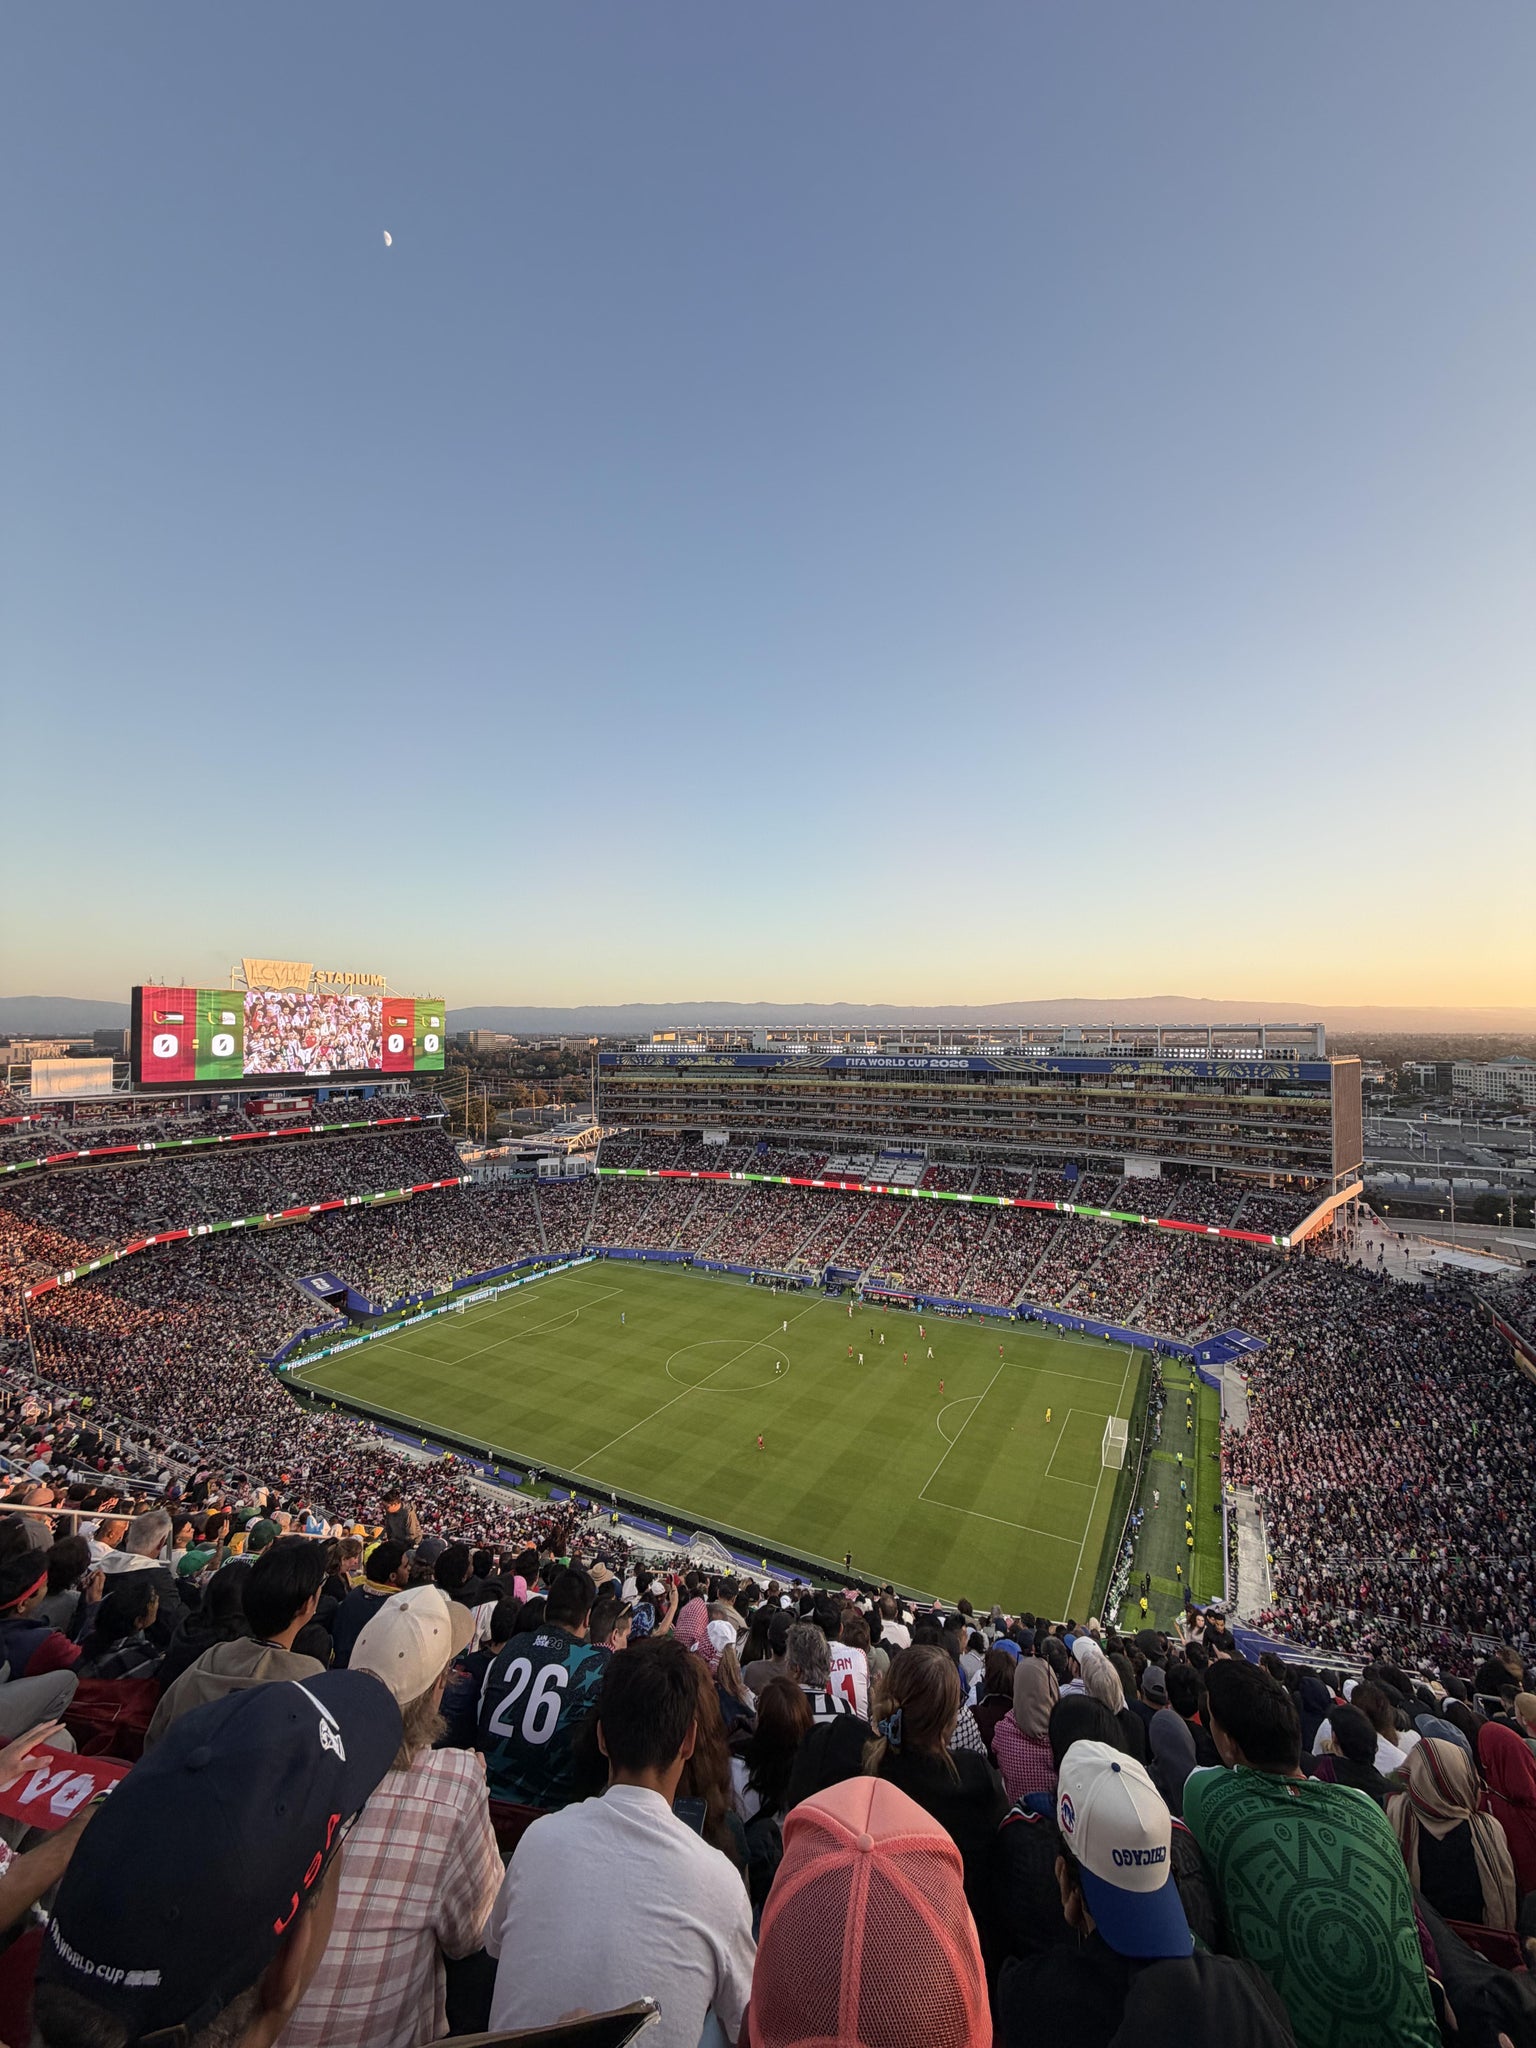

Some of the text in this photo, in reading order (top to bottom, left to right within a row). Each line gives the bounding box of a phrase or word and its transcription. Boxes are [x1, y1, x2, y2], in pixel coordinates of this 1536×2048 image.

[315, 970, 383, 987] STADIUM
[153, 1034, 178, 1058] 0
[212, 1034, 234, 1057] 0
[845, 1058, 970, 1068] FIFA WORLD CUP 2026
[369, 1323, 400, 1340] Hisense
[330, 1338, 364, 1355] Hisense
[287, 1353, 324, 1371] Hisense
[829, 1657, 853, 1672] ZAN
[488, 1657, 569, 1745] 26
[826, 1674, 857, 1714] 1
[1112, 1846, 1167, 1867] CHICAGO
[58, 1937, 95, 1975] WORLD
[96, 1964, 125, 1985] CUP
